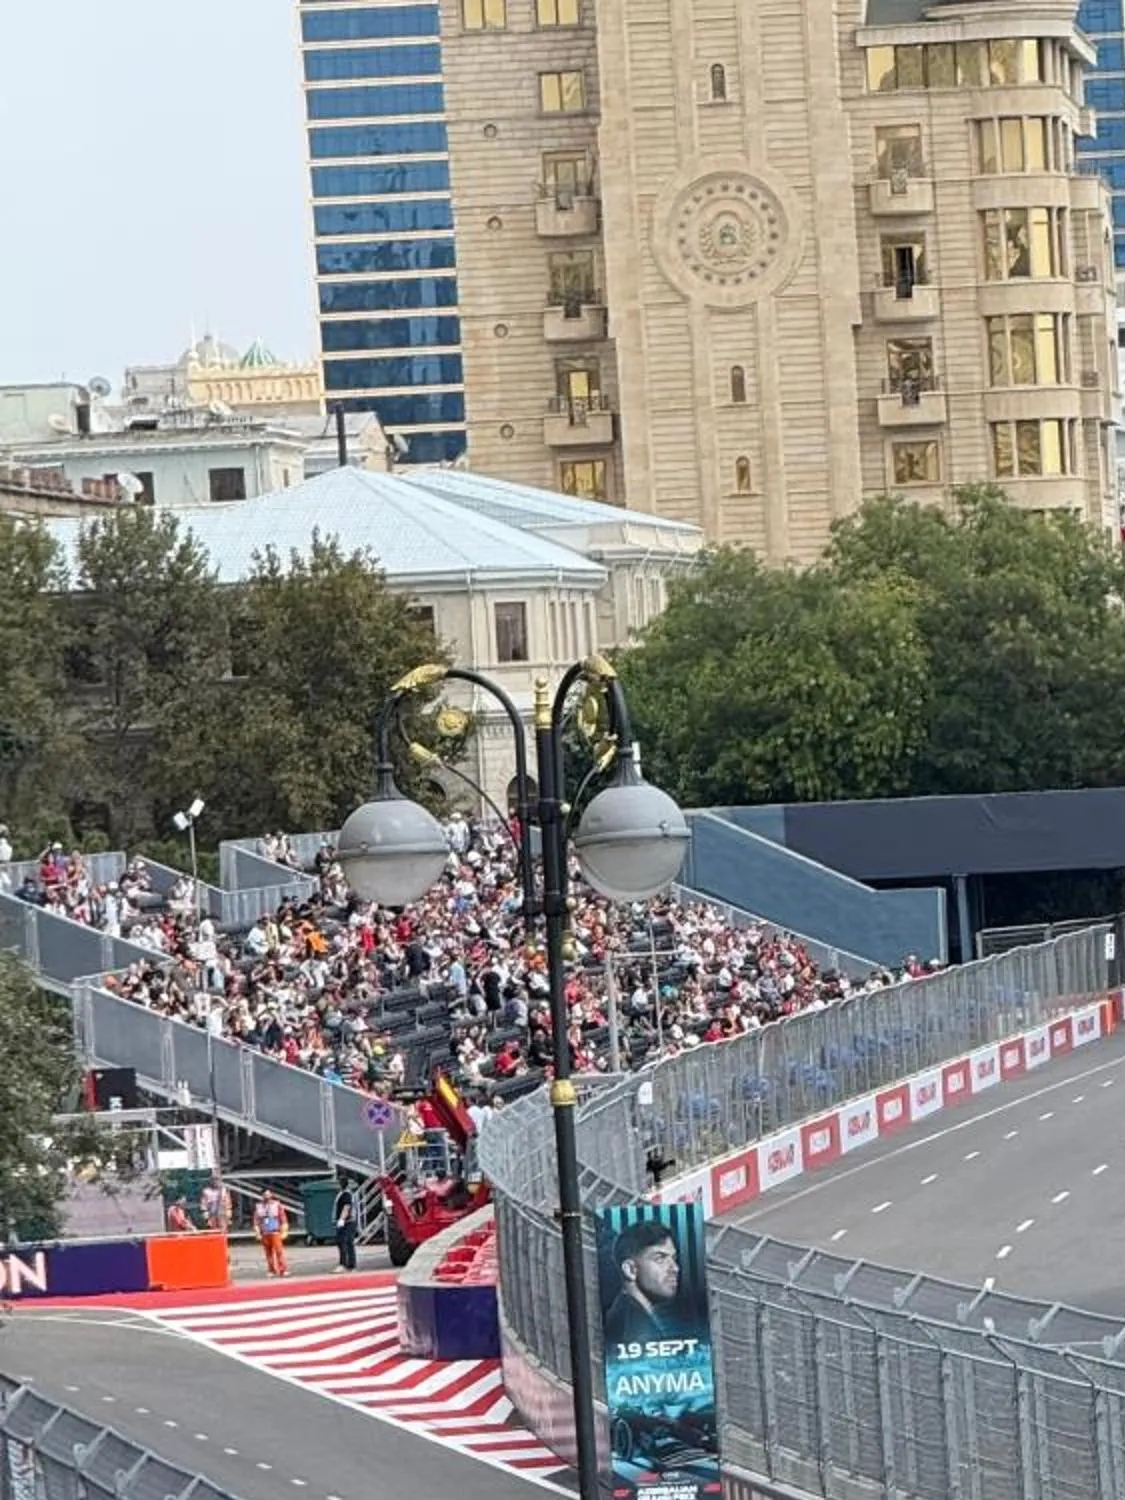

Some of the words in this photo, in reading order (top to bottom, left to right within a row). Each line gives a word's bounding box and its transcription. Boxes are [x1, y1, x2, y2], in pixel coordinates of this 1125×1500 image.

[0, 1250, 47, 1293] N
[617, 1342, 642, 1360] 19
[645, 1338, 699, 1357] SEPT
[615, 1371, 705, 1396] ANYMA
